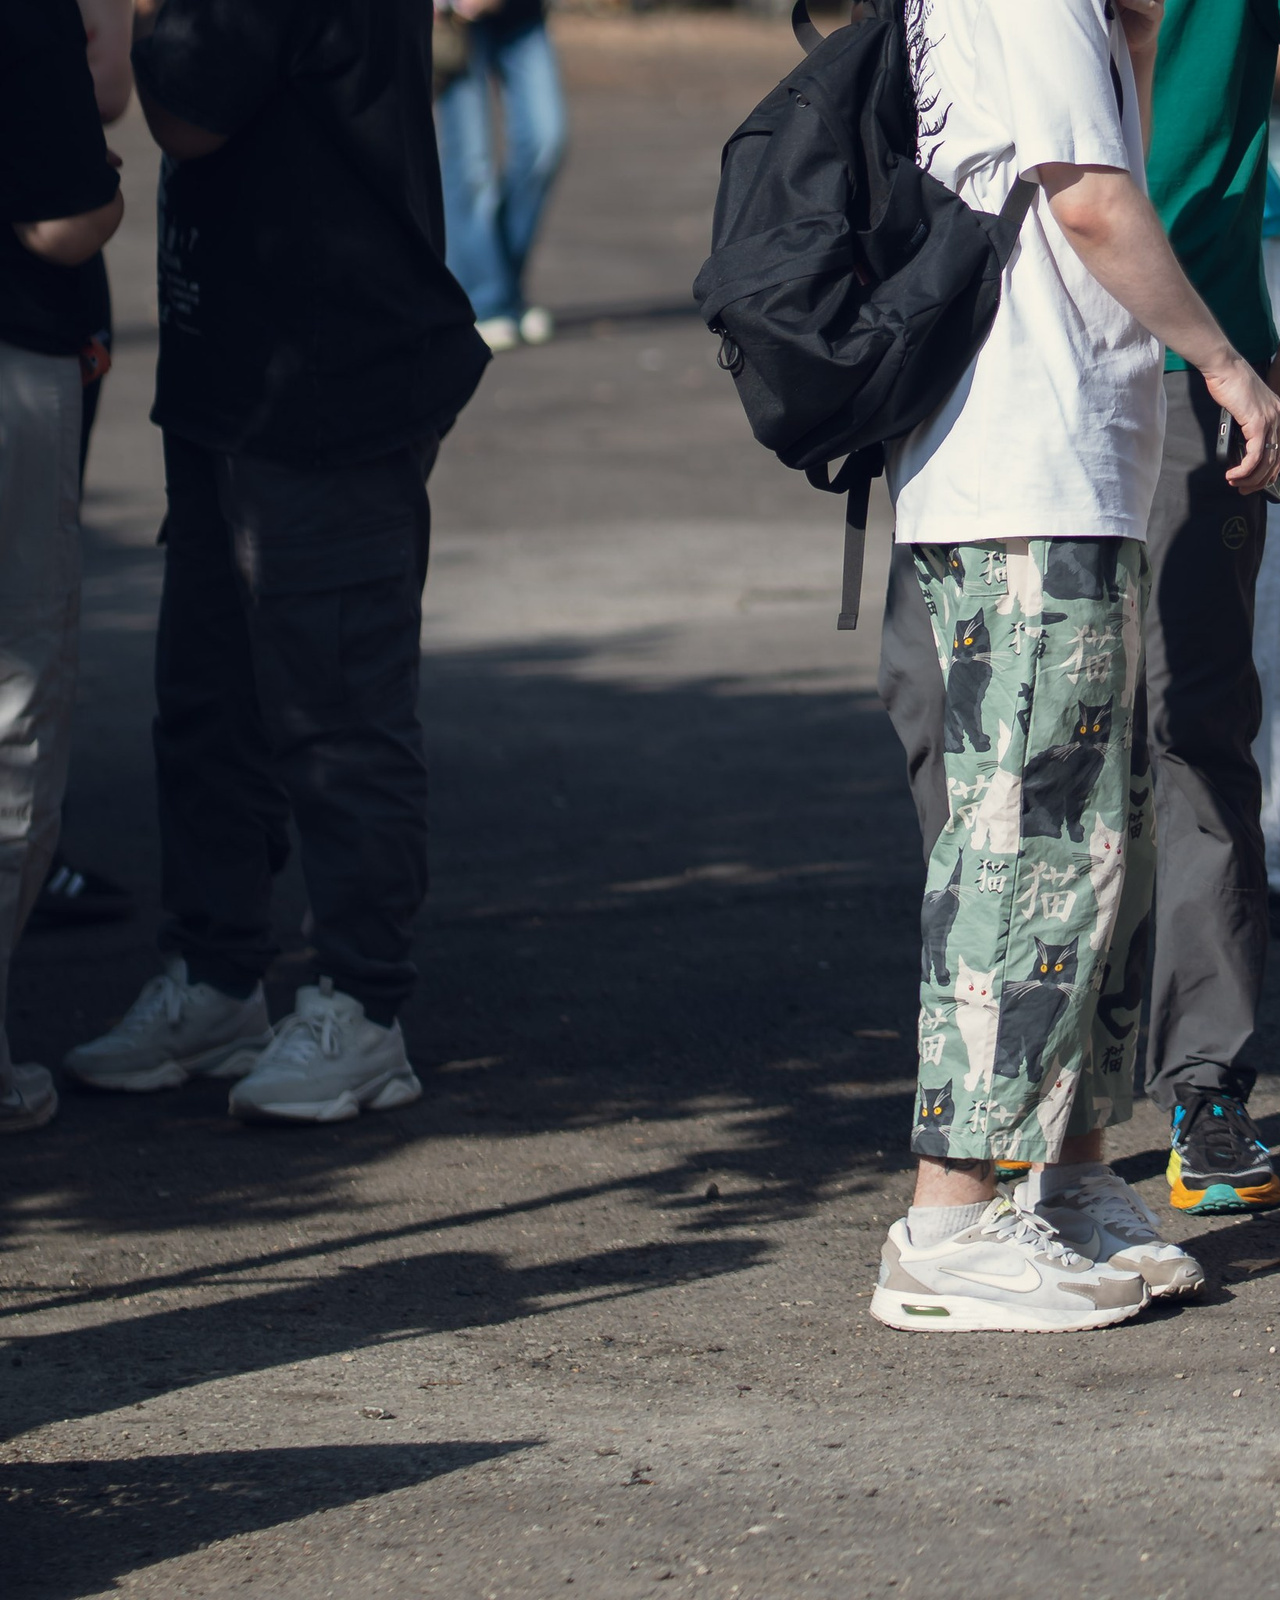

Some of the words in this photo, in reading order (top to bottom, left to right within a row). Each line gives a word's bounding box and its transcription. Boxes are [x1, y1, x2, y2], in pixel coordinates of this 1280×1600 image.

[1060, 624, 1116, 685] 猫
[975, 858, 1009, 893] 猫
[1016, 861, 1079, 923] 猫
[1101, 1043, 1125, 1075] 猫
